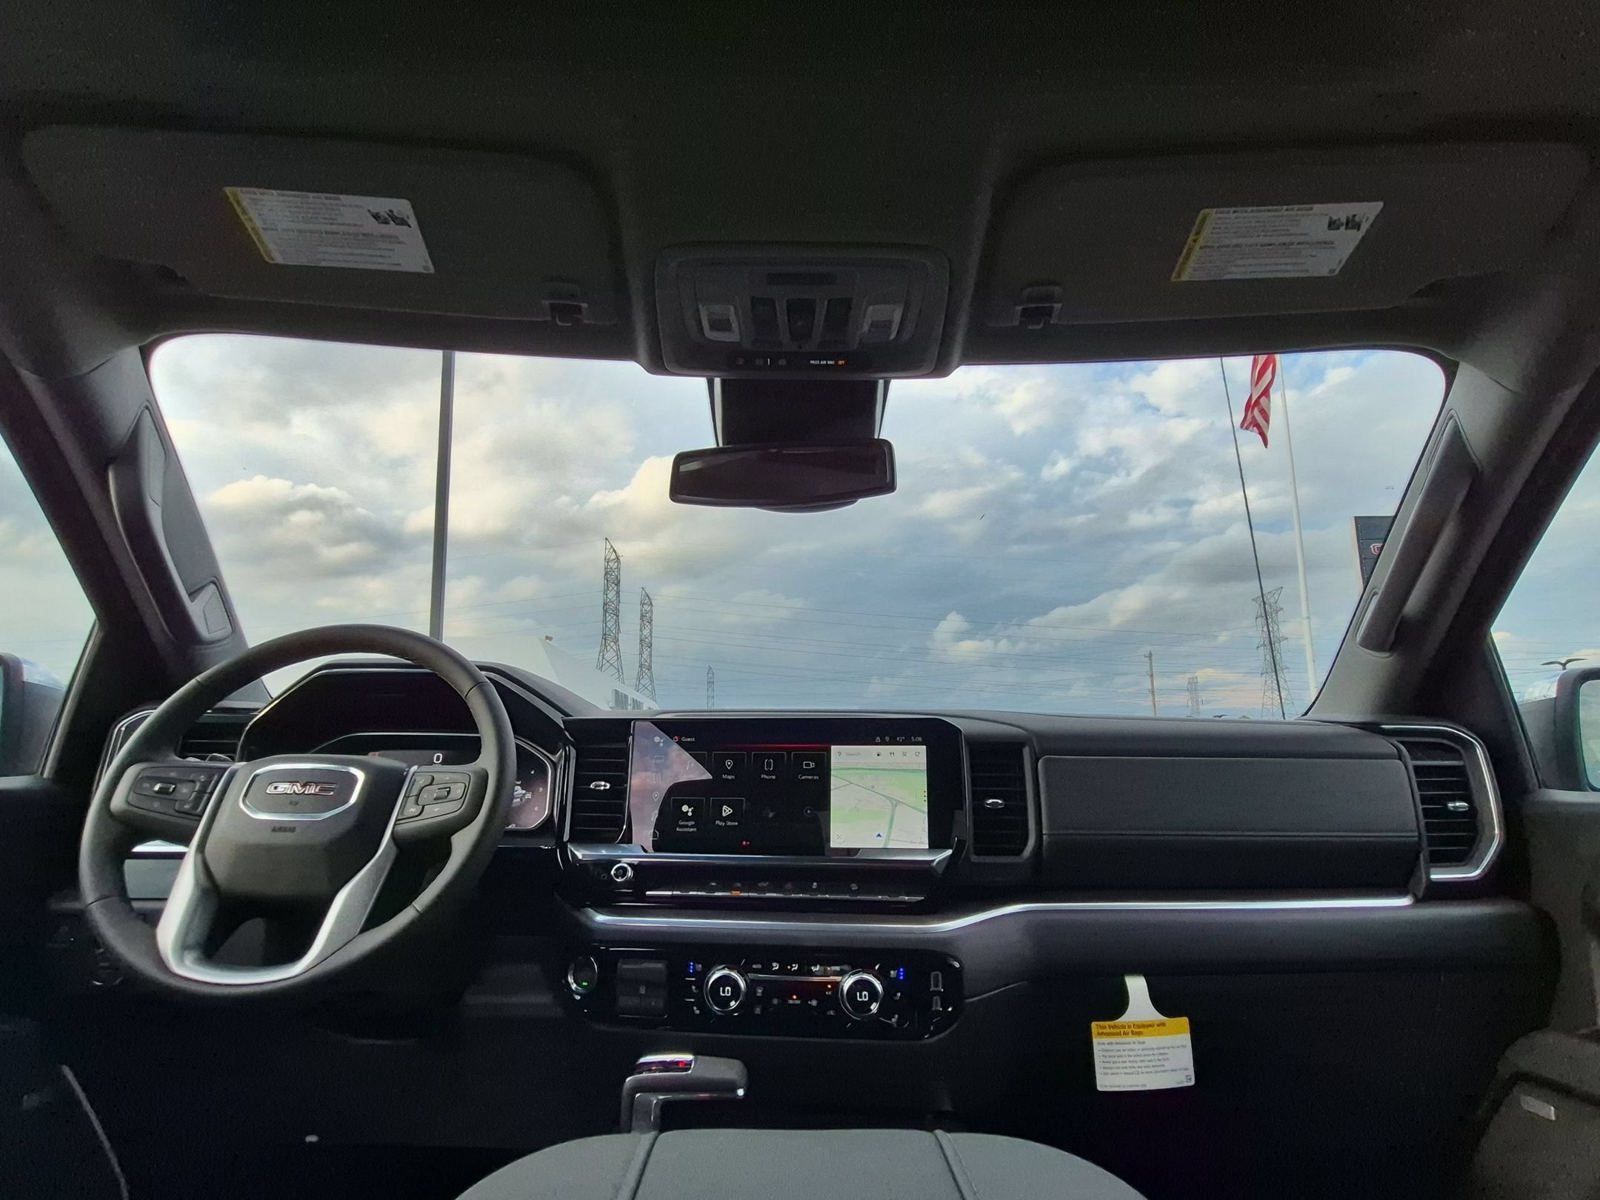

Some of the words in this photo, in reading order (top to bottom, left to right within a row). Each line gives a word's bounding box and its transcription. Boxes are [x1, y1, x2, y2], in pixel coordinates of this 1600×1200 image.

[433, 753, 443, 763] 0
[266, 782, 337, 796] GMC
[715, 819, 726, 827] Play
[720, 986, 732, 996] LO
[856, 991, 869, 1001] LO
